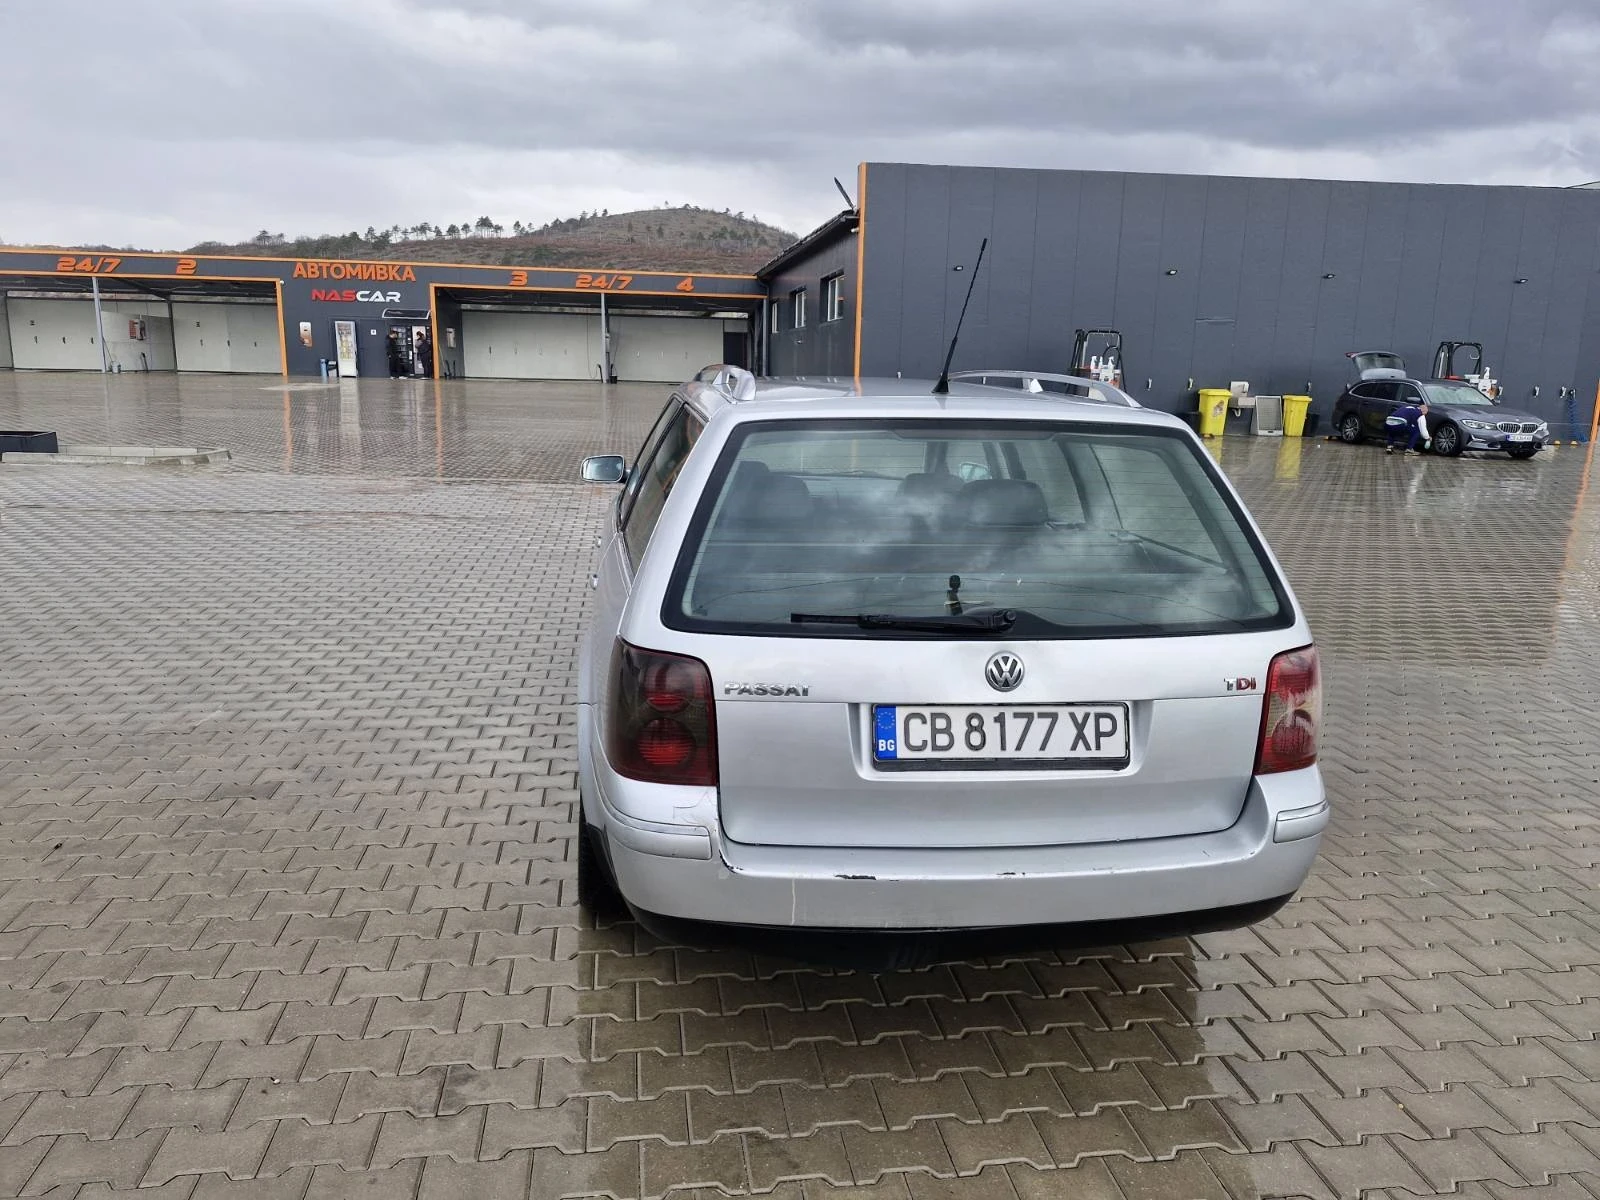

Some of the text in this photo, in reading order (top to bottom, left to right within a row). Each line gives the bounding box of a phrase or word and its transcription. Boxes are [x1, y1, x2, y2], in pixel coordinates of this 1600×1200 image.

[56, 256, 121, 273] 24/7
[175, 258, 197, 275] 2
[293, 261, 417, 282] АВТОМИВКА
[508, 270, 528, 287] 3
[575, 273, 633, 290] 24/7
[675, 276, 695, 293] 4
[311, 288, 401, 303] NASCAR
[723, 681, 813, 697] PASSAT
[903, 711, 1118, 751] CB 8177 XP
[878, 739, 895, 751] BG
